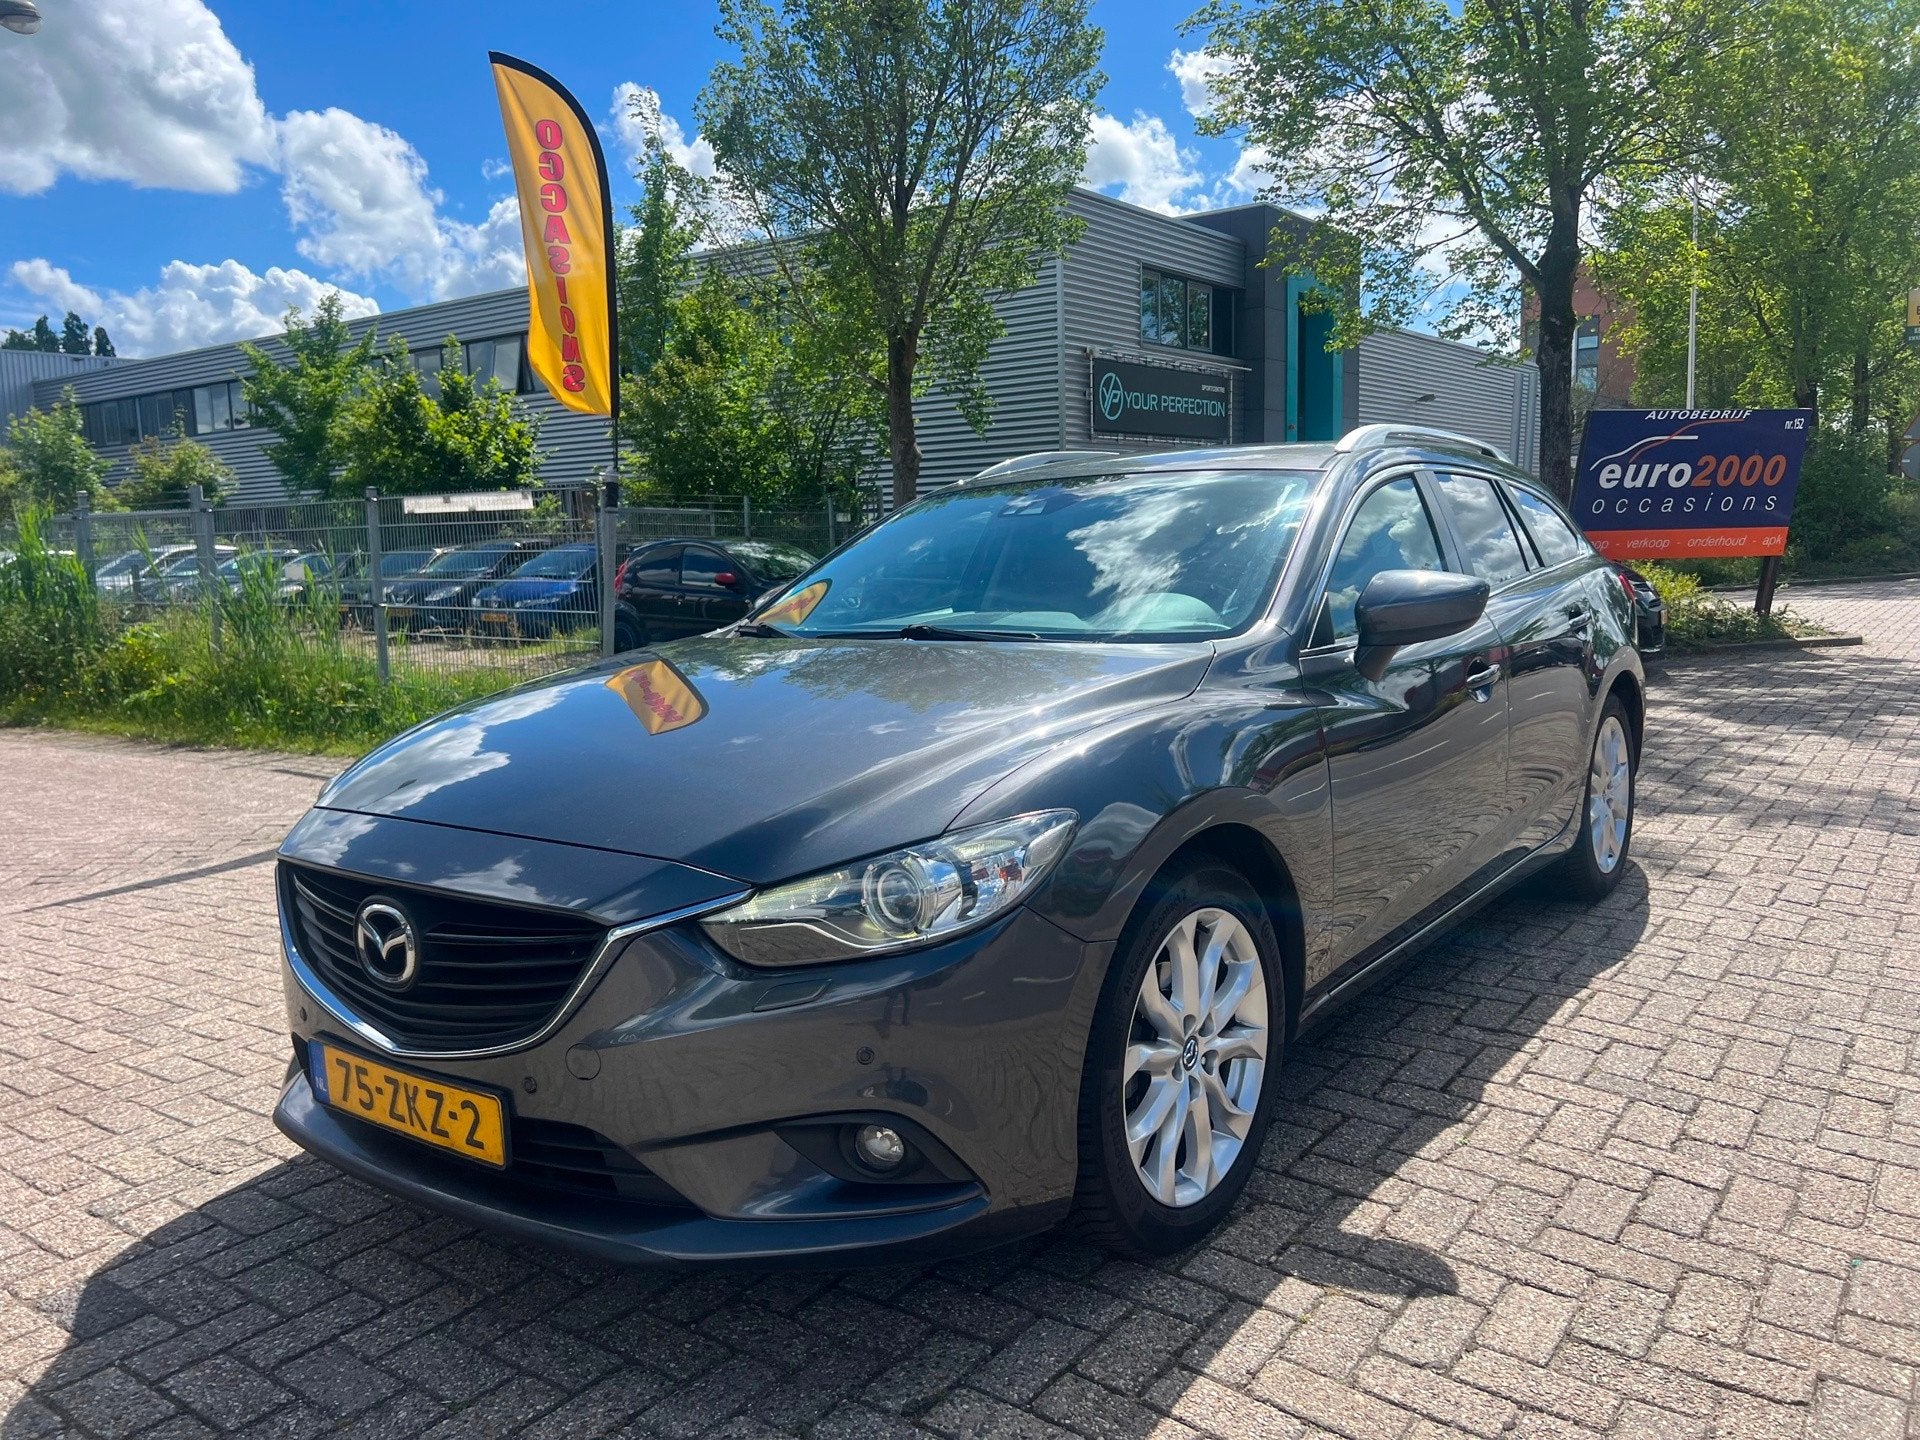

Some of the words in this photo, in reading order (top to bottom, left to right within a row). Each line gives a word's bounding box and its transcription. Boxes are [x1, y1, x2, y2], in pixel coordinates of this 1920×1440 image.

[1124, 391, 1158, 411] YOUR
[1161, 395, 1226, 417] PERFECTION
[1644, 409, 1752, 420] AUTOBEDRIJF
[1599, 454, 1787, 489] euro2000
[1591, 493, 1777, 514] occasions
[1626, 538, 1670, 550] verkoop
[1687, 536, 1746, 548] onderhoud
[1762, 535, 1782, 547] apk
[314, 1076, 327, 1092] NL
[336, 1057, 485, 1150] 75-ZKZ-2
